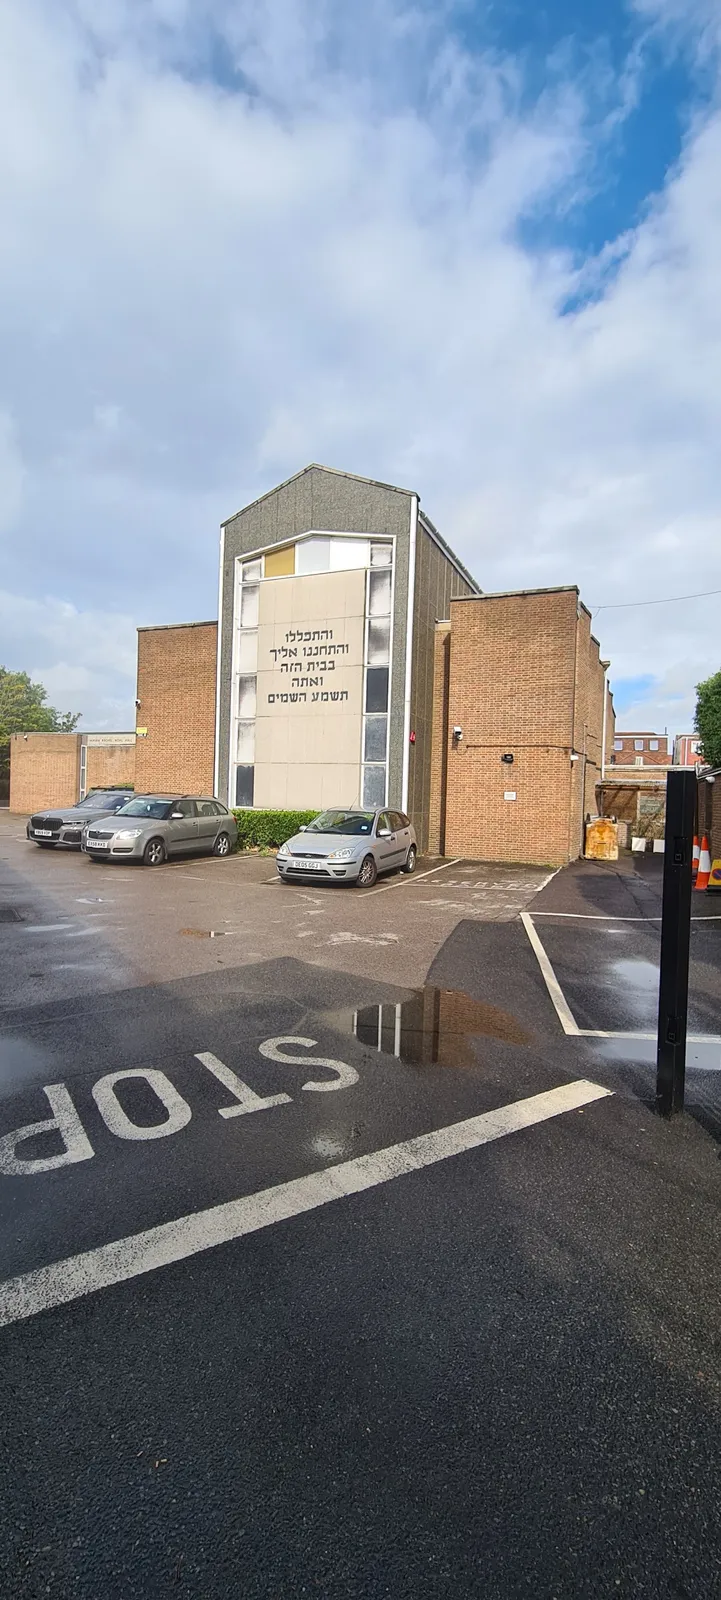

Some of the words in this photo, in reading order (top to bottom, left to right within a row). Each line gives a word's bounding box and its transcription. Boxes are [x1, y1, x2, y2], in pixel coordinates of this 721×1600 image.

[285, 629, 333, 643] והתפללו
[269, 646, 298, 662] אליך
[302, 644, 349, 657] והתחננו
[280, 662, 302, 673] הזה
[306, 660, 335, 672] בבית
[291, 676, 323, 687] ואתה
[267, 692, 307, 704] השמים
[311, 690, 348, 702] תשמע
[0, 1035, 360, 1176] STOP
